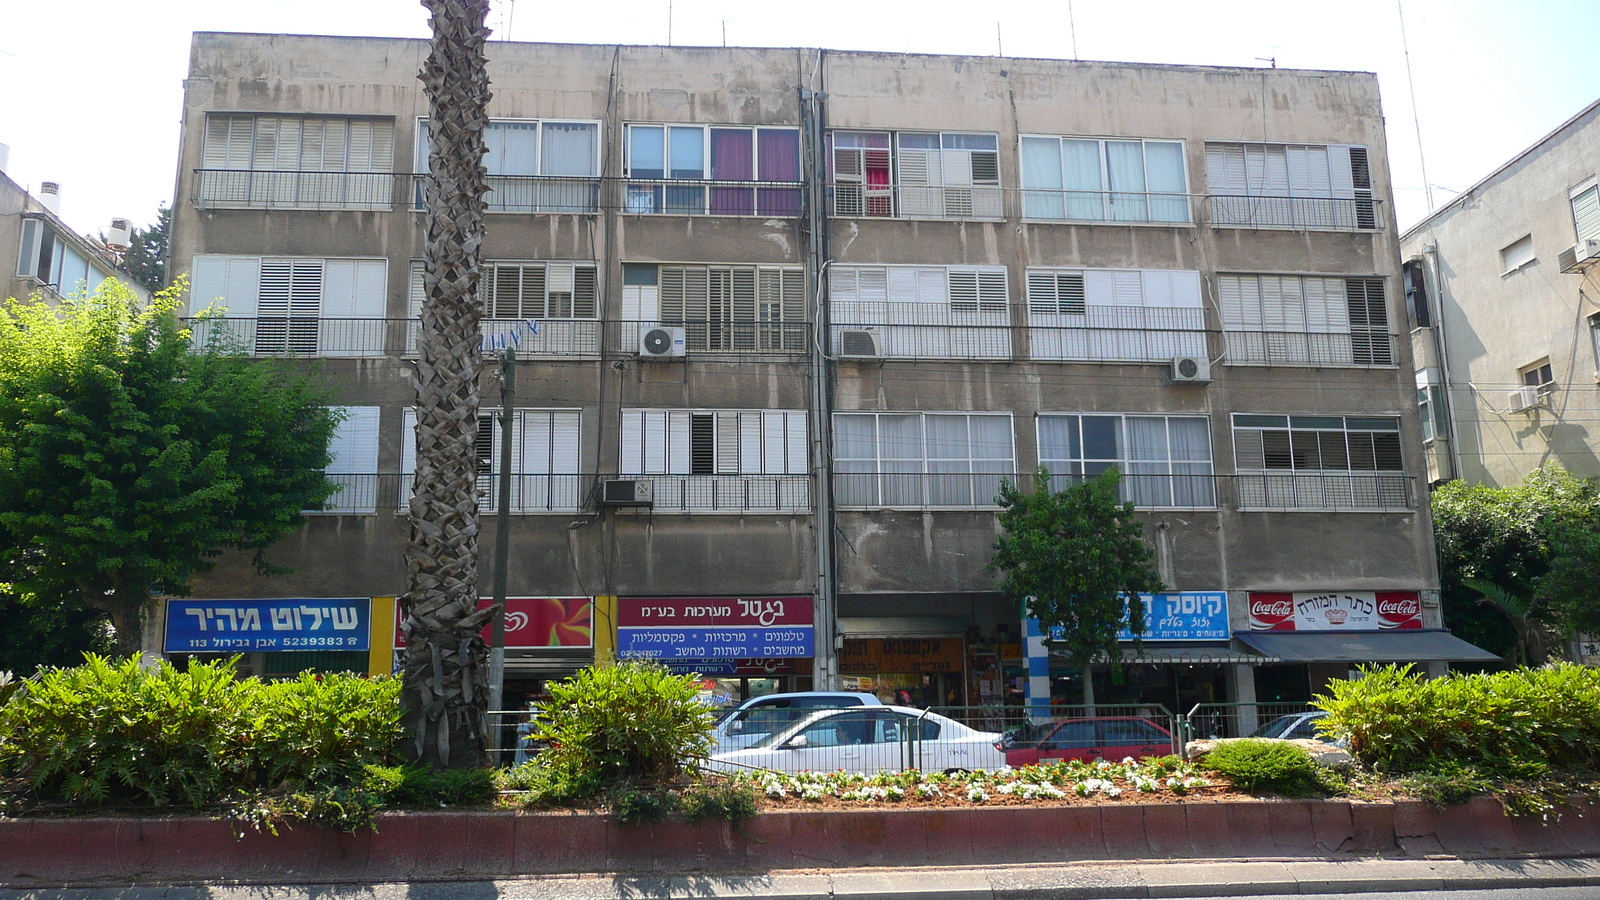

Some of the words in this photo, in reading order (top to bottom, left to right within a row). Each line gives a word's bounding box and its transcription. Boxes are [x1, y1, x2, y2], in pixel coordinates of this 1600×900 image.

[1166, 595, 1222, 617] קיוסק
[1252, 600, 1292, 615] Coca-Cola
[1297, 594, 1338, 616] המזרח
[1345, 595, 1373, 615] כתר
[1378, 599, 1417, 615] Coca-Cola
[684, 606, 731, 617] מערכות
[737, 598, 785, 626] בגטל
[185, 607, 262, 631] מהיר
[270, 605, 359, 631] שילוט
[213, 637, 250, 647] גבירול
[283, 637, 343, 646] 5239383
[631, 631, 685, 644] פקסמליות
[705, 632, 747, 642] מרכזיות
[765, 630, 805, 642] טלפונים
[189, 639, 207, 647] 113
[256, 638, 276, 648] אבן
[675, 646, 705, 657] מחשב
[712, 646, 747, 656] רשתות
[763, 645, 805, 655] מחשבים
